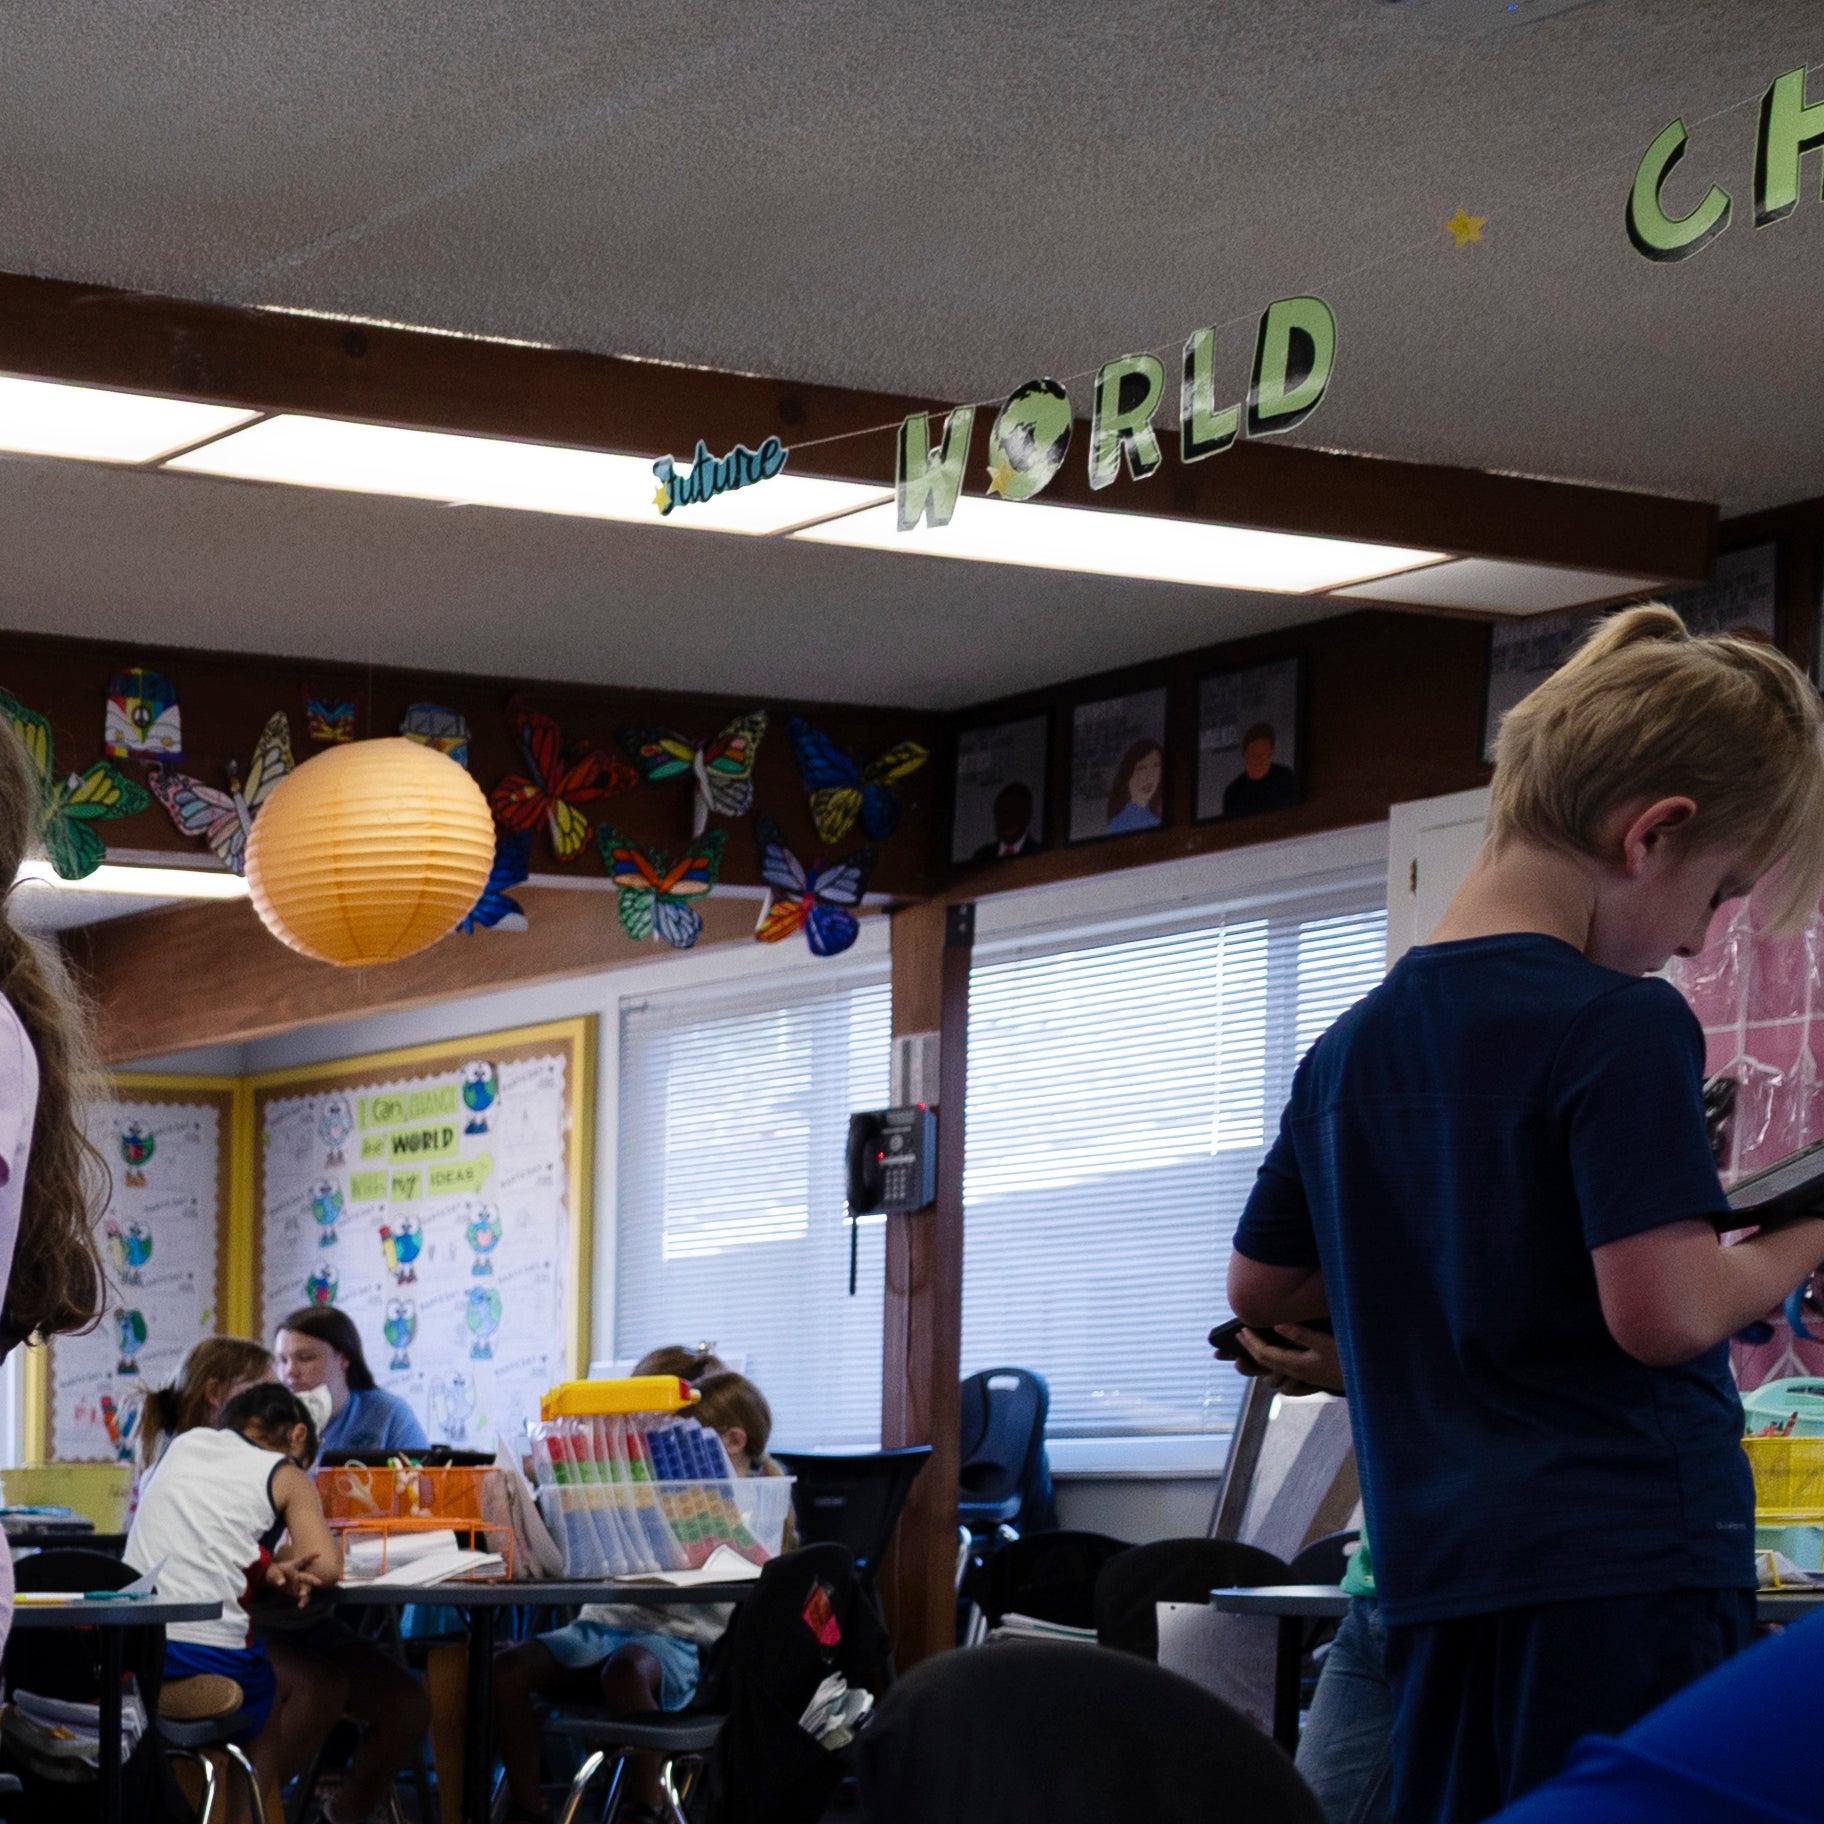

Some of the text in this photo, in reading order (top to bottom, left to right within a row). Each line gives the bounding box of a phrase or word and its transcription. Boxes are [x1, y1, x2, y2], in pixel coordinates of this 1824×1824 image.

[896, 294, 1340, 533] WORLD
[652, 434, 789, 516] Future
[392, 1127, 453, 1155] WORLD
[430, 1167, 473, 1186] IDEAS
